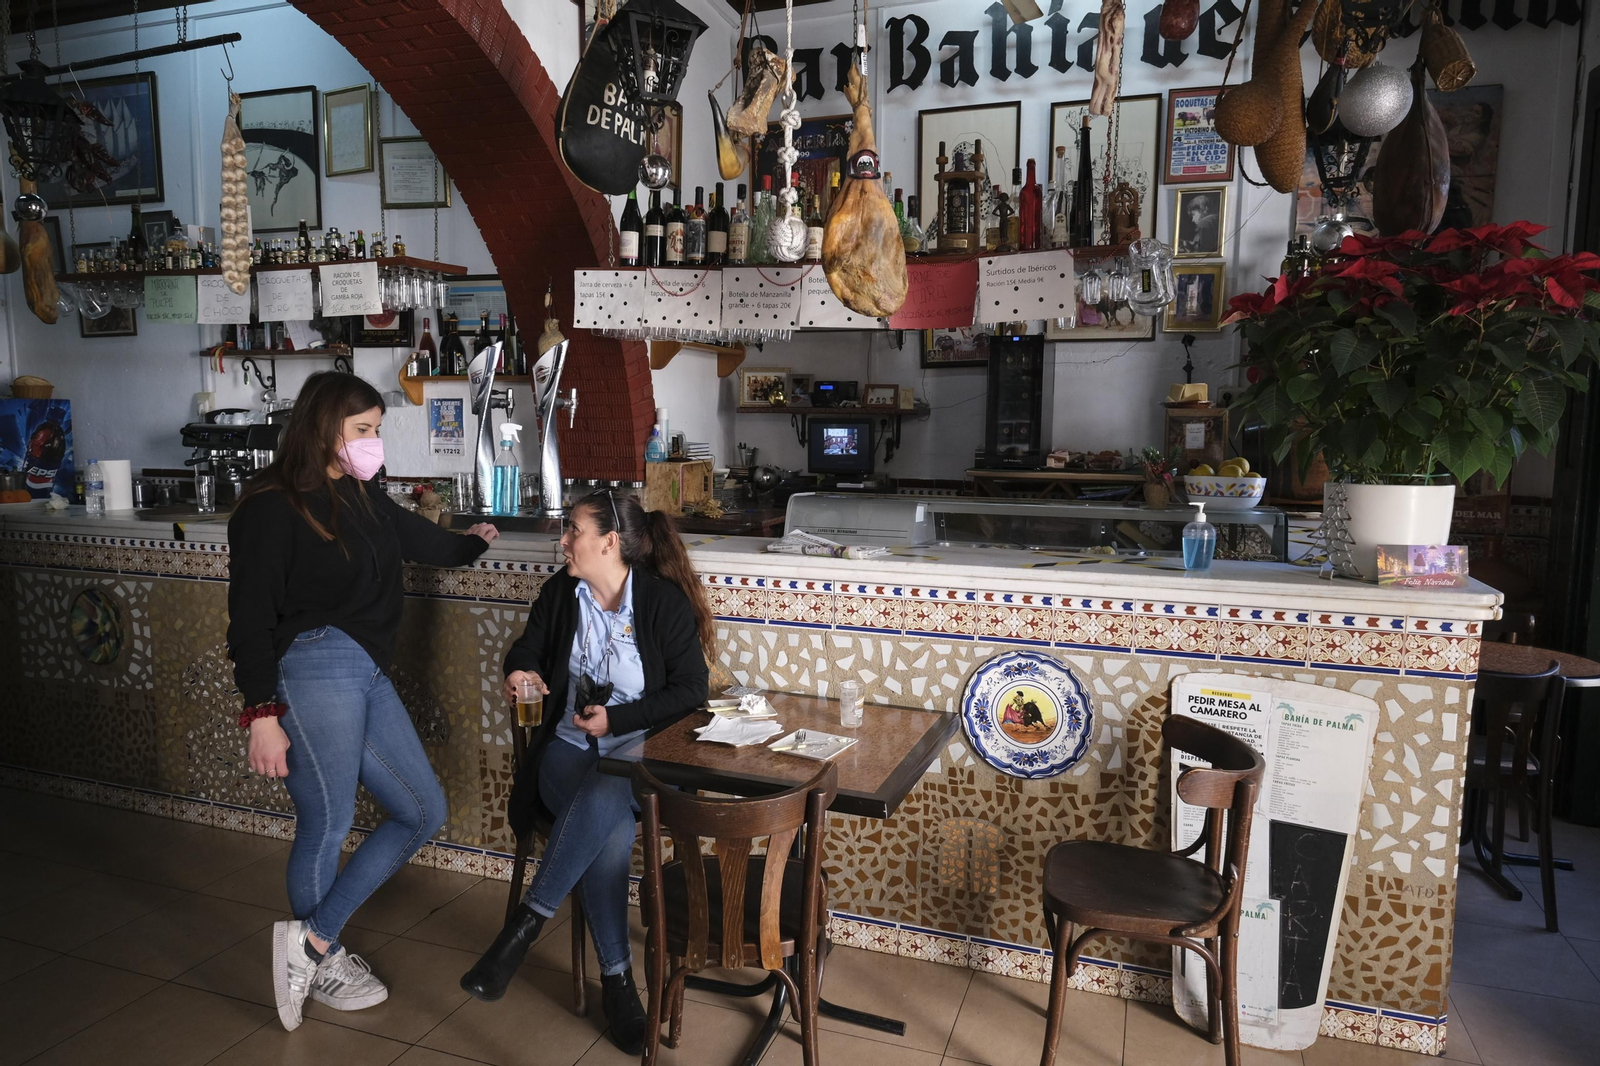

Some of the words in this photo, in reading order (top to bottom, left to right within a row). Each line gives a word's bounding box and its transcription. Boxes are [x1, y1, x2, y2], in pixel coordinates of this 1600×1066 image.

[1175, 98, 1208, 108] ROQUETAS
[586, 104, 612, 130] DE
[1187, 143, 1226, 151] FERRERA
[936, 270, 953, 280] DE
[986, 267, 1015, 277] Surtidos
[1016, 266, 1026, 274] de
[1028, 264, 1057, 272] Ibéricos
[259, 275, 308, 286] CROQUETAS
[216, 294, 230, 302] DE
[202, 306, 244, 317] CHOCO
[1454, 510, 1475, 518] DEL
[1476, 510, 1501, 519] MAR
[1403, 577, 1421, 586] Feliz
[1424, 578, 1456, 586] Navidad
[1188, 695, 1216, 706] PEDIR
[1218, 699, 1247, 710] MESA
[1248, 703, 1262, 712] AL
[1189, 705, 1248, 720] CAMARERO
[1284, 713, 1310, 724] BAHÍA
[1312, 718, 1323, 727] DE
[1326, 720, 1354, 731] PALMA
[1222, 725, 1247, 733] RESPETE
[1240, 909, 1267, 920] PALMA
